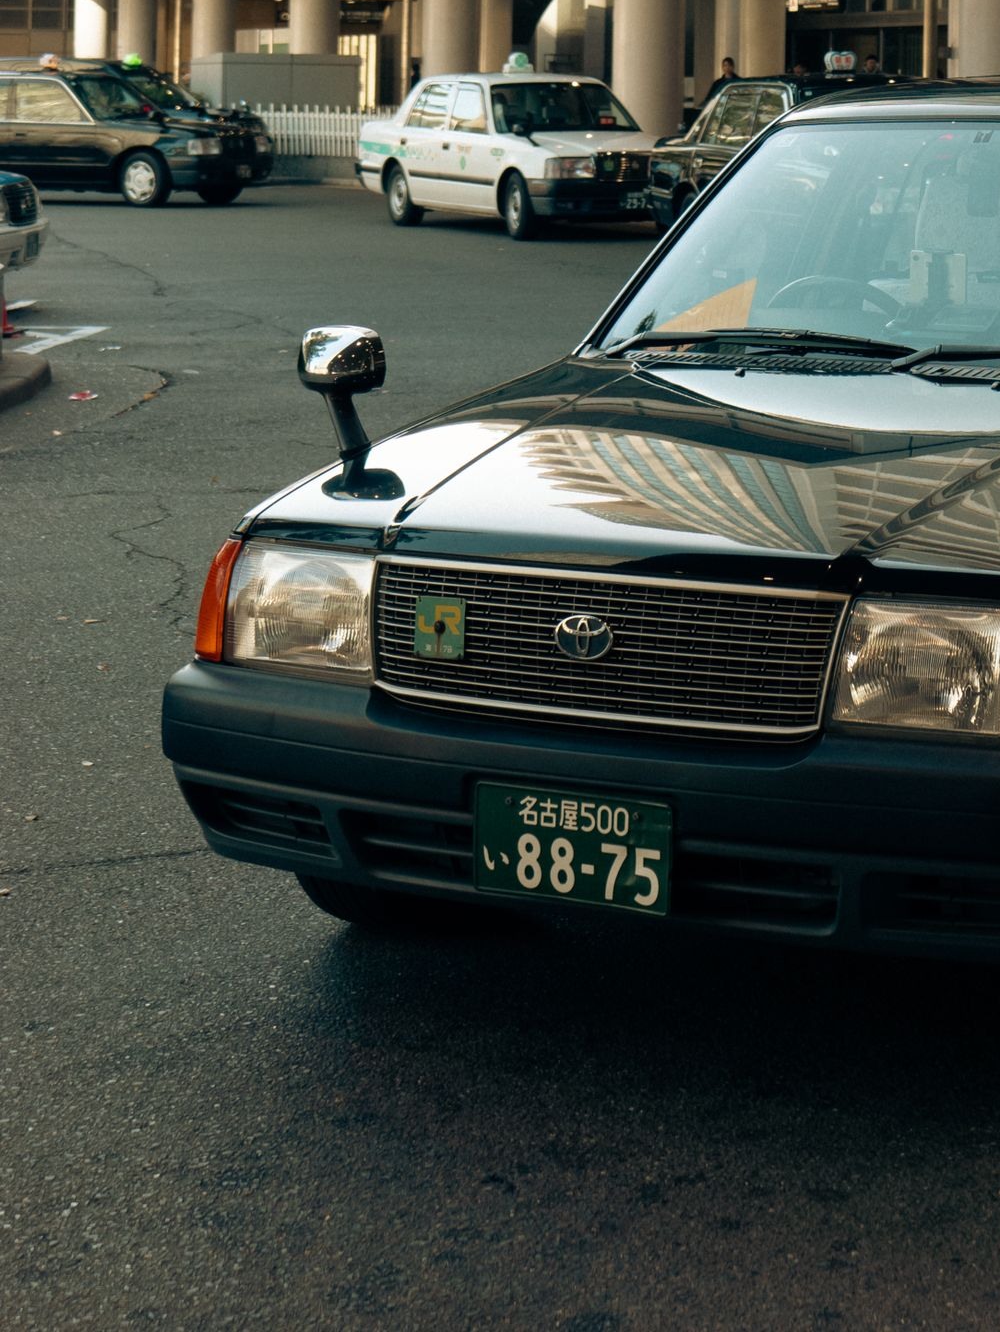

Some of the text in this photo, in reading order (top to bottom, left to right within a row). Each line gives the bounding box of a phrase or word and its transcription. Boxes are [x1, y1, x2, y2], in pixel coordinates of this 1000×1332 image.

[418, 604, 461, 636] JR
[519, 795, 630, 837] 名古屋500
